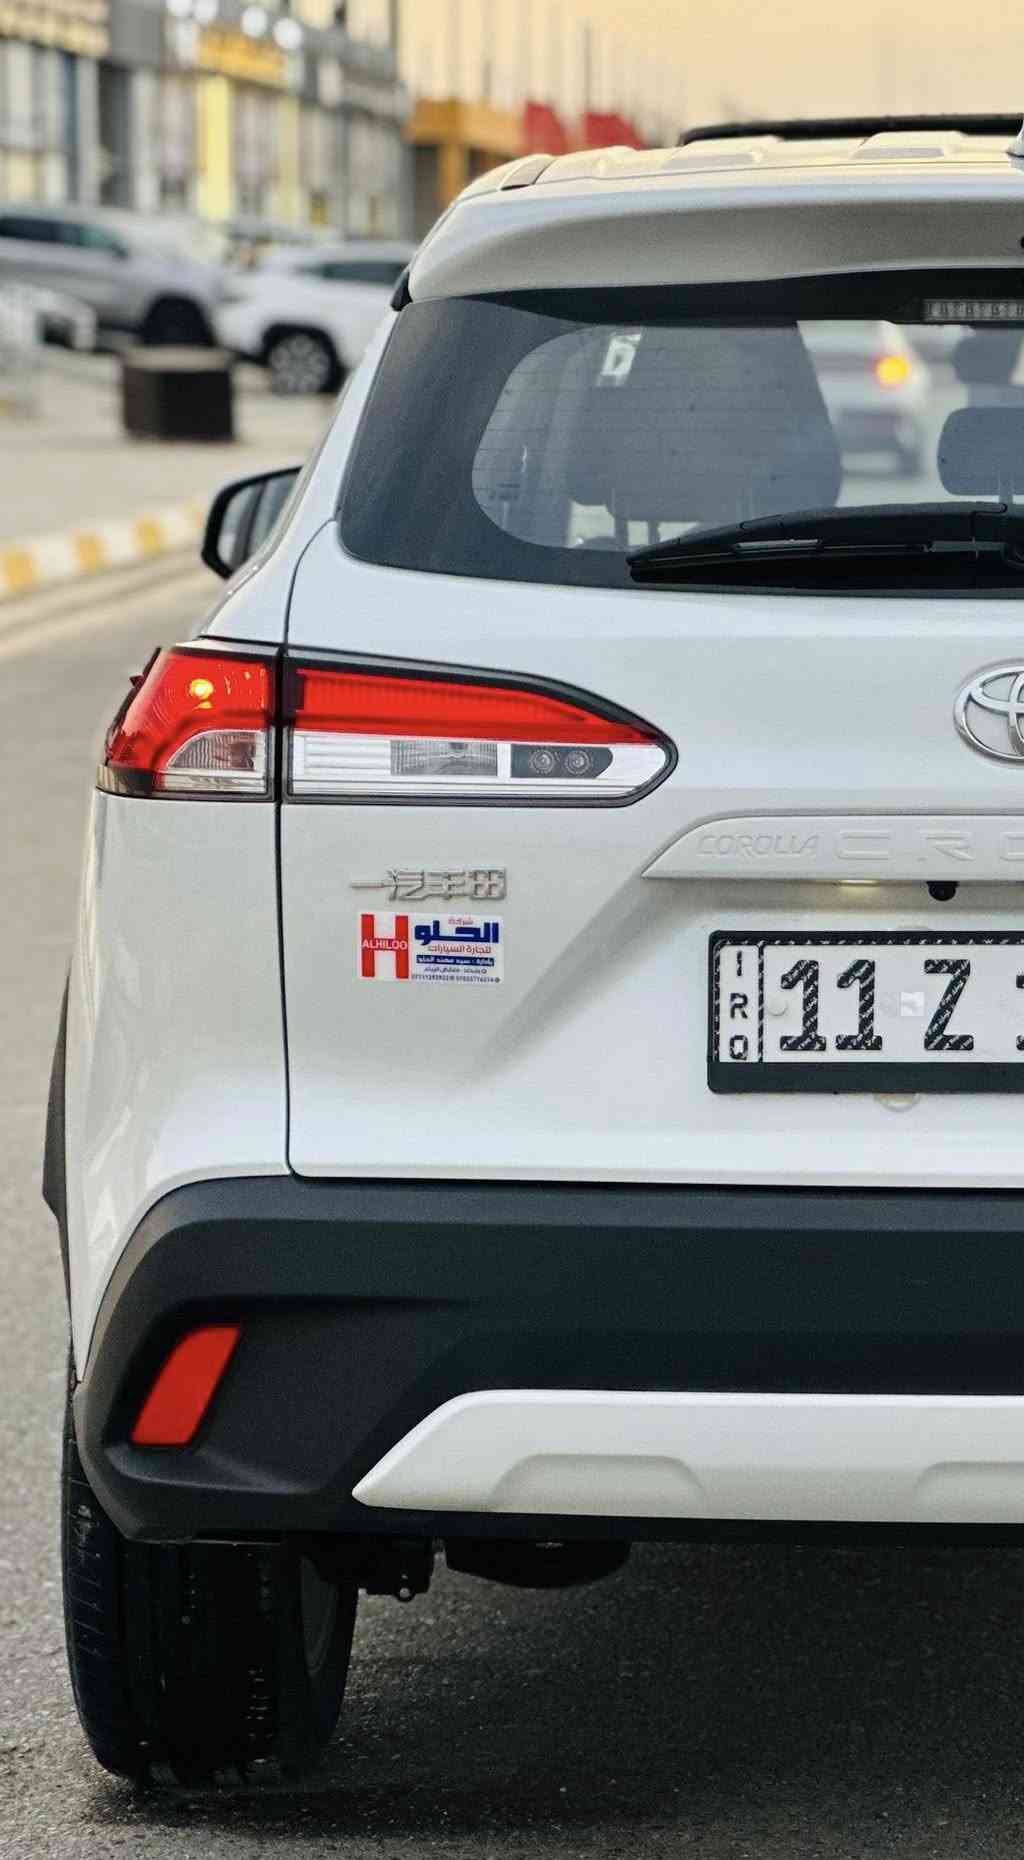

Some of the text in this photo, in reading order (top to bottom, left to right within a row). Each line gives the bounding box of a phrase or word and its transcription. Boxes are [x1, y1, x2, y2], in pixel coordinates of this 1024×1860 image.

[699, 833, 821, 857] COROLLA
[413, 919, 500, 947] الحلو
[779, 958, 884, 1052] 11
[923, 958, 976, 1052] Z
